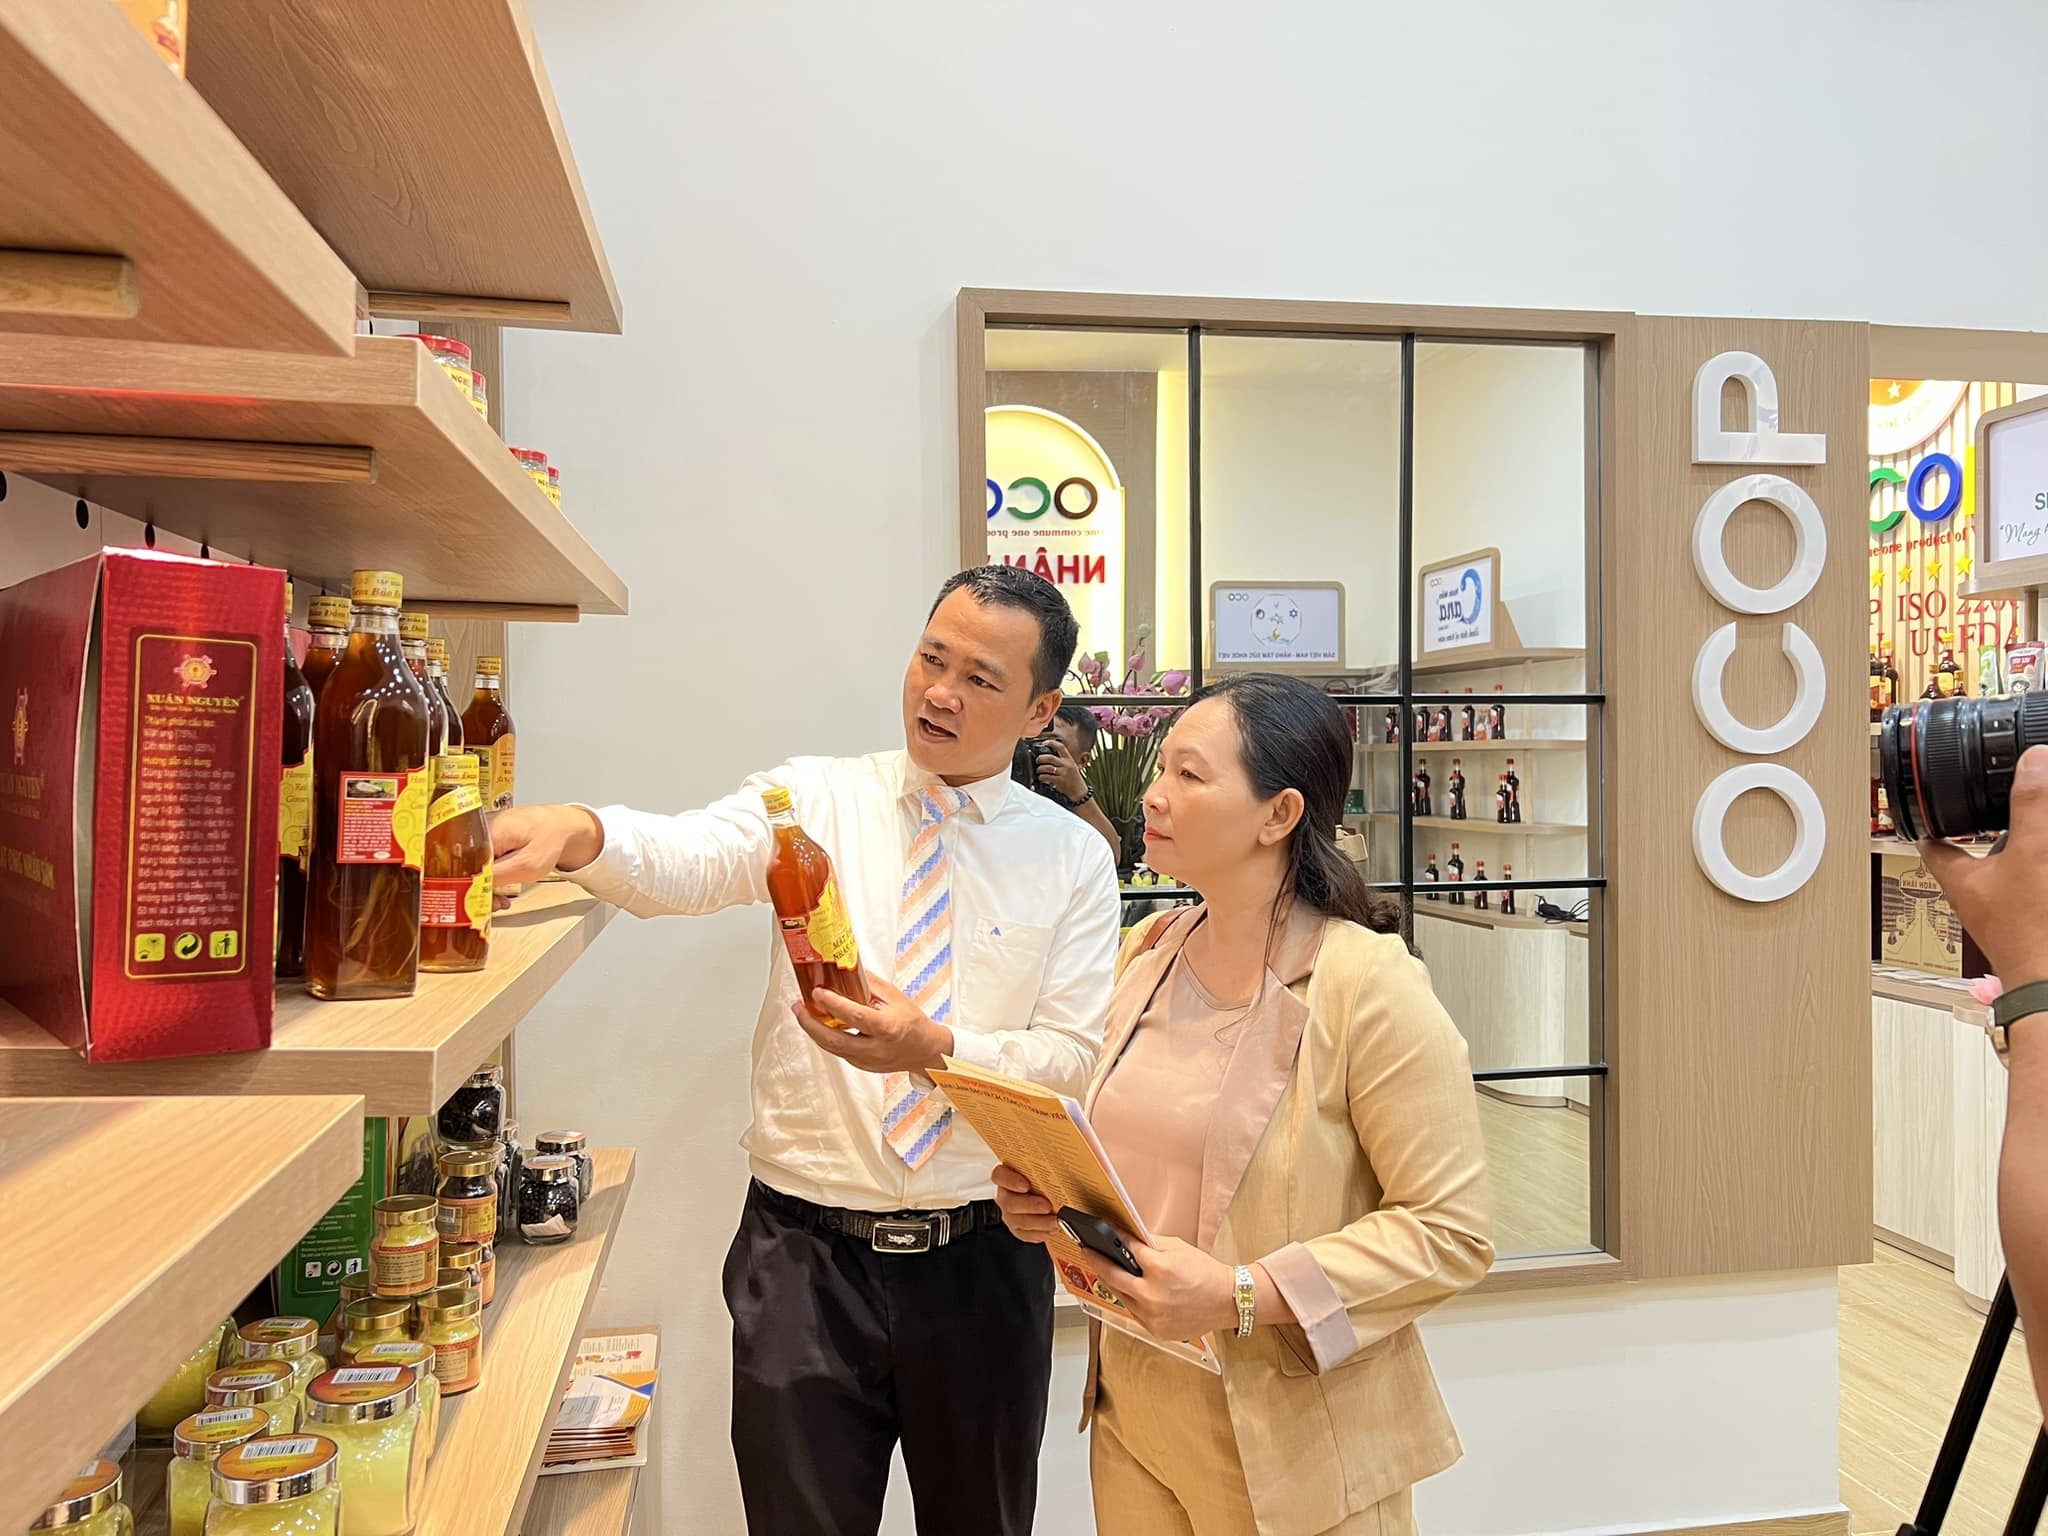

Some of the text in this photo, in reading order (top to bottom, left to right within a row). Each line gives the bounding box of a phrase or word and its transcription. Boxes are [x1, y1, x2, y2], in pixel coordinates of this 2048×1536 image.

[1906, 530, 1951, 553] product
[1955, 527, 1968, 541] of
[1897, 589, 1947, 622] ISO
[1692, 350, 1826, 903] OCOP
[146, 693, 185, 705] XUÂN
